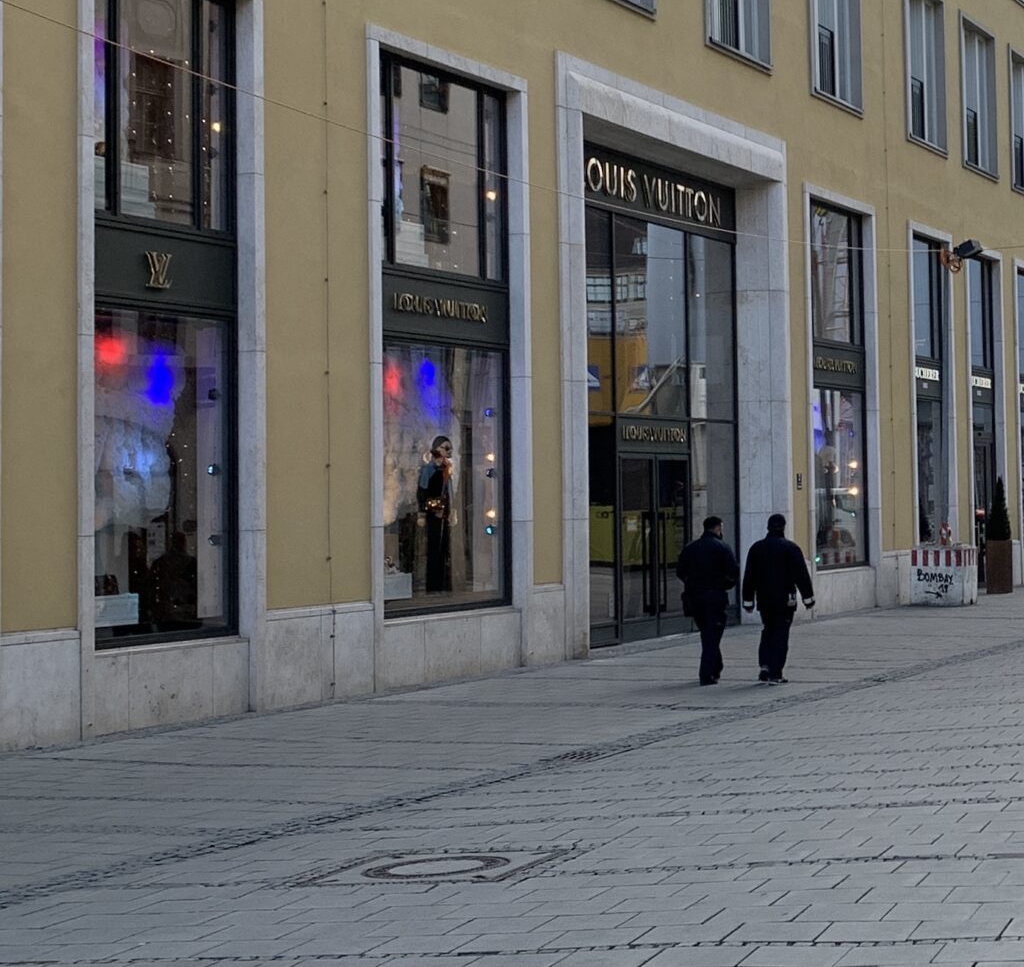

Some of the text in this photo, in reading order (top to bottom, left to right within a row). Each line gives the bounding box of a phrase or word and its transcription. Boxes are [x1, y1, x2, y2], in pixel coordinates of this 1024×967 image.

[585, 157, 721, 228] OUIS VUITTON
[394, 292, 489, 323] LOUIS VUITTON
